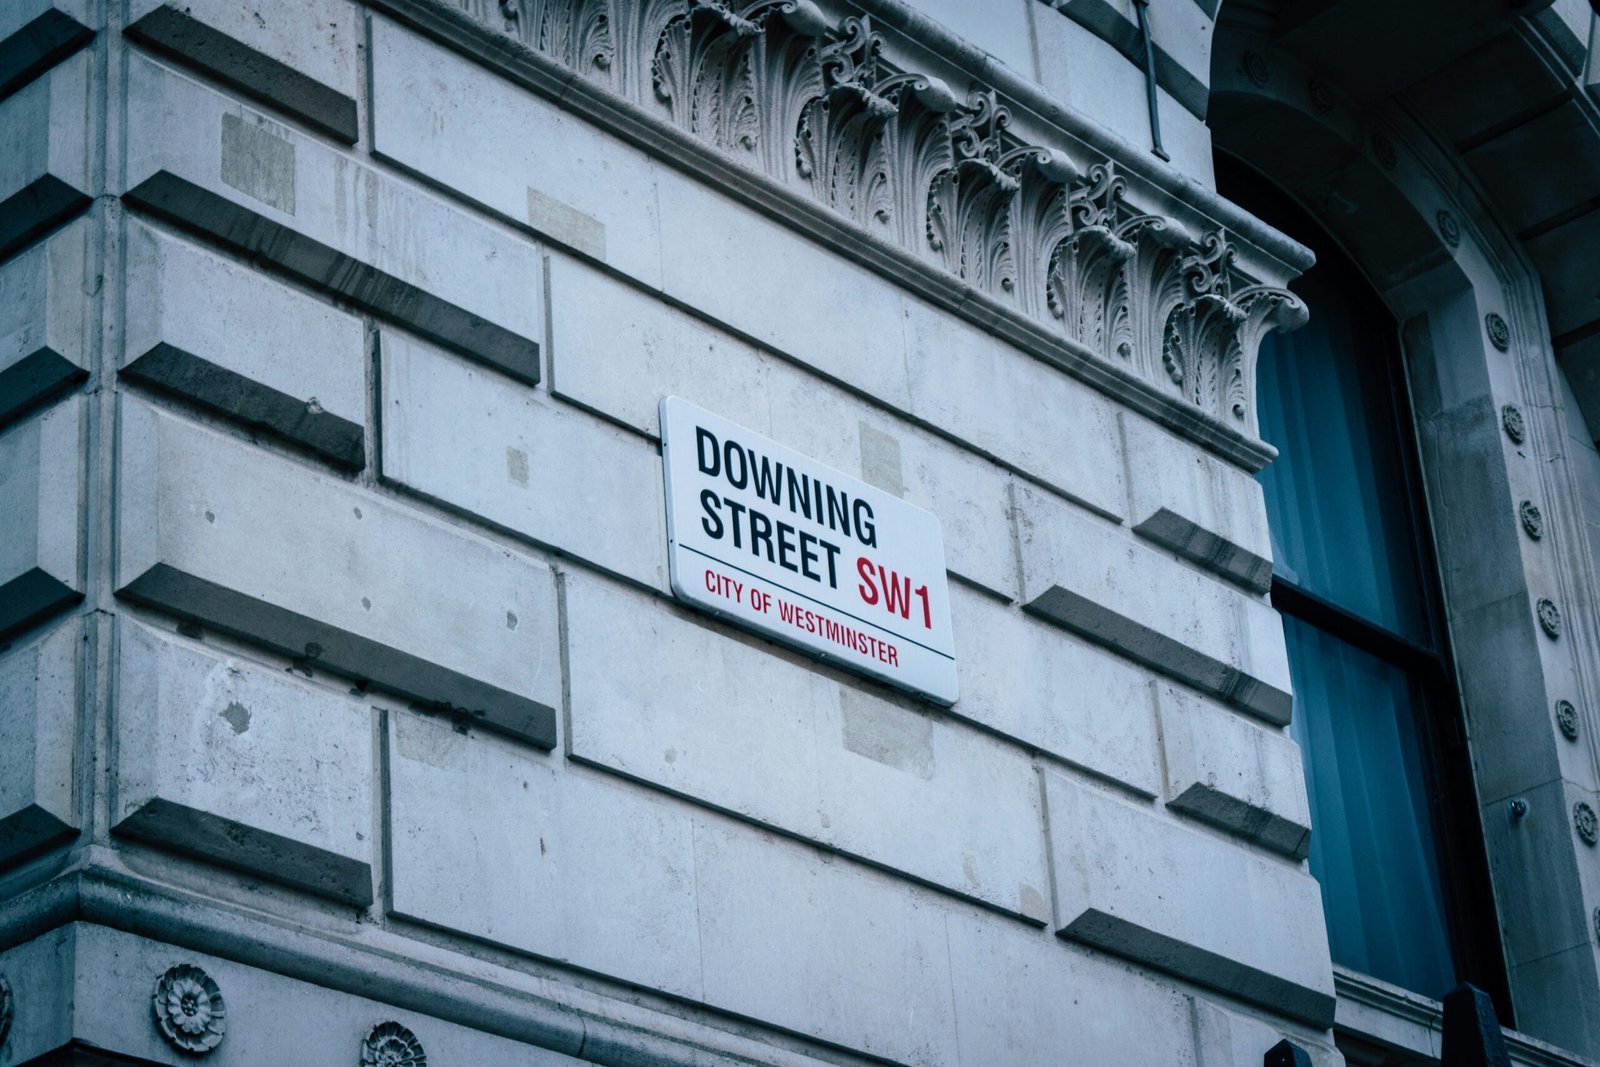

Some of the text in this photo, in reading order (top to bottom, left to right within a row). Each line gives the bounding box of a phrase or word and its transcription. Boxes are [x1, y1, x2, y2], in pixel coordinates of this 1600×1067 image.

[696, 425, 877, 549] DOWNING
[700, 488, 932, 629] STREET SW1
[705, 569, 899, 667] CITY OF WESTMINSTER
